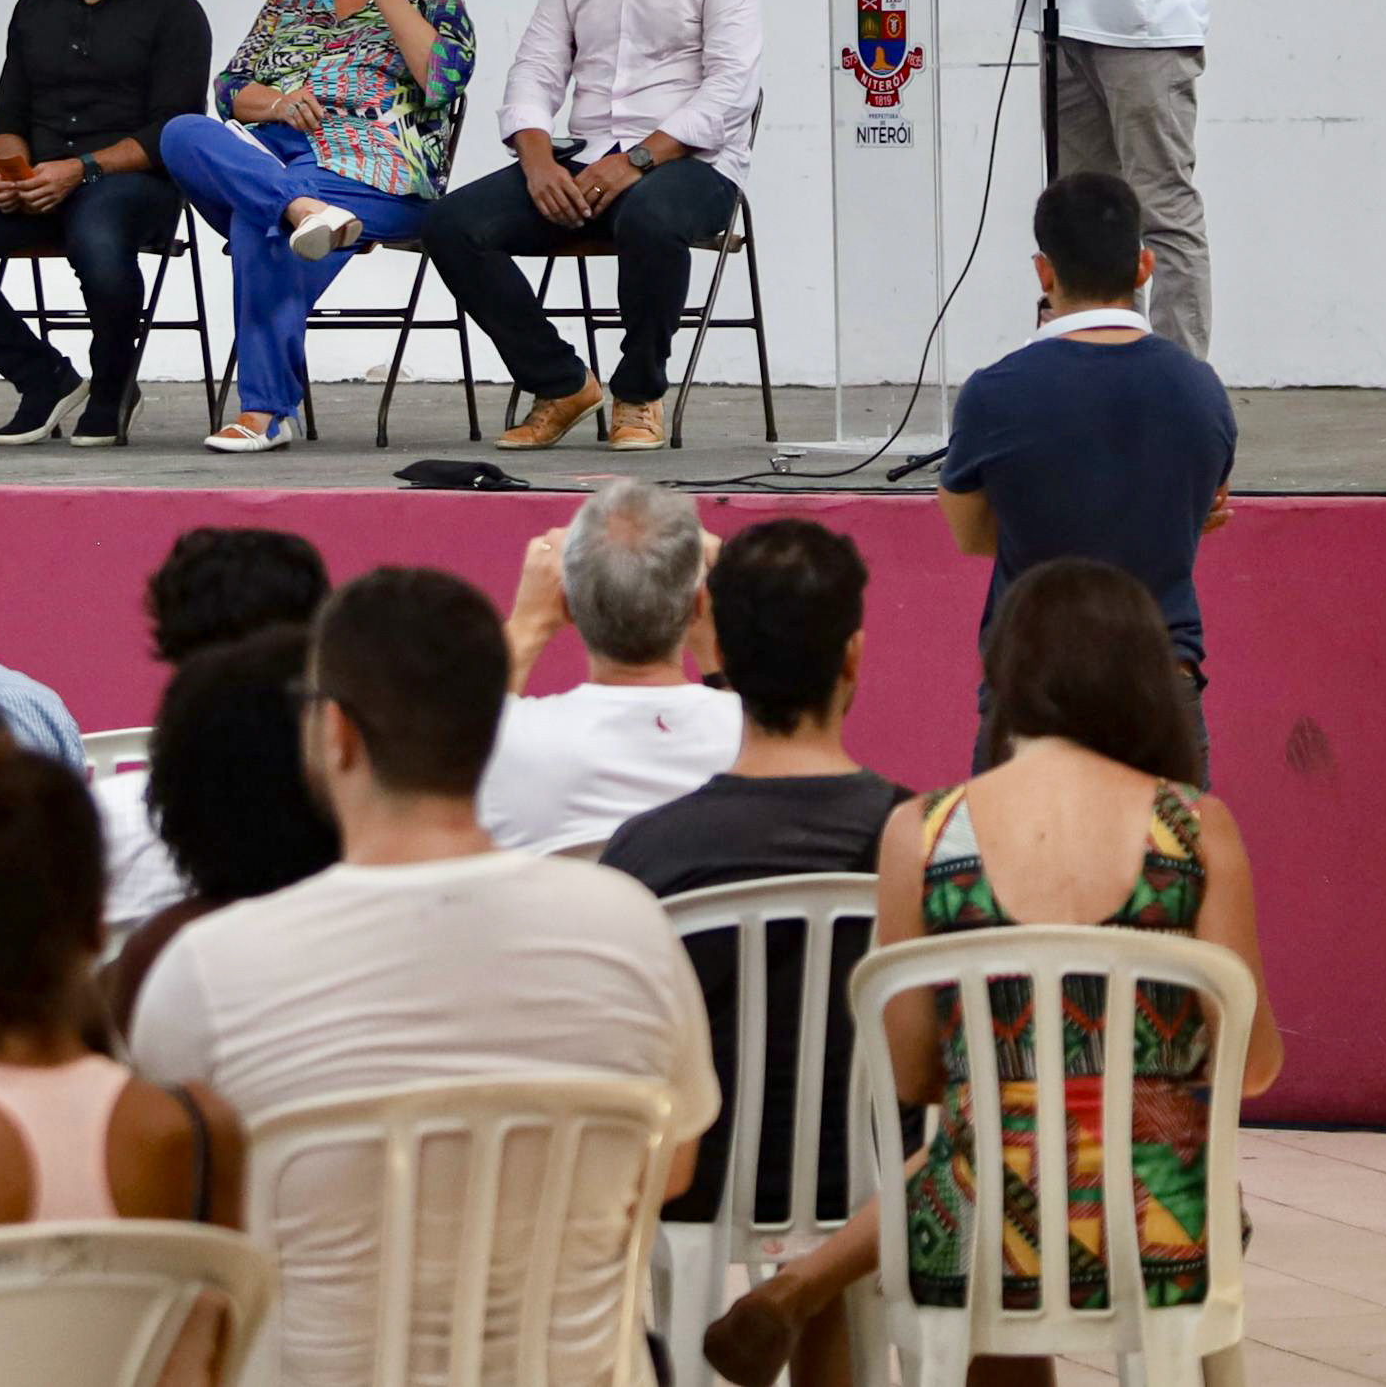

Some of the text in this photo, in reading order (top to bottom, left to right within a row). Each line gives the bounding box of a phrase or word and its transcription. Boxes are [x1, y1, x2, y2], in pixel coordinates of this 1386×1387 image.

[860, 72, 905, 91] NITERÓI
[874, 95, 893, 106] 1819
[856, 122, 911, 144] NITERÓI
